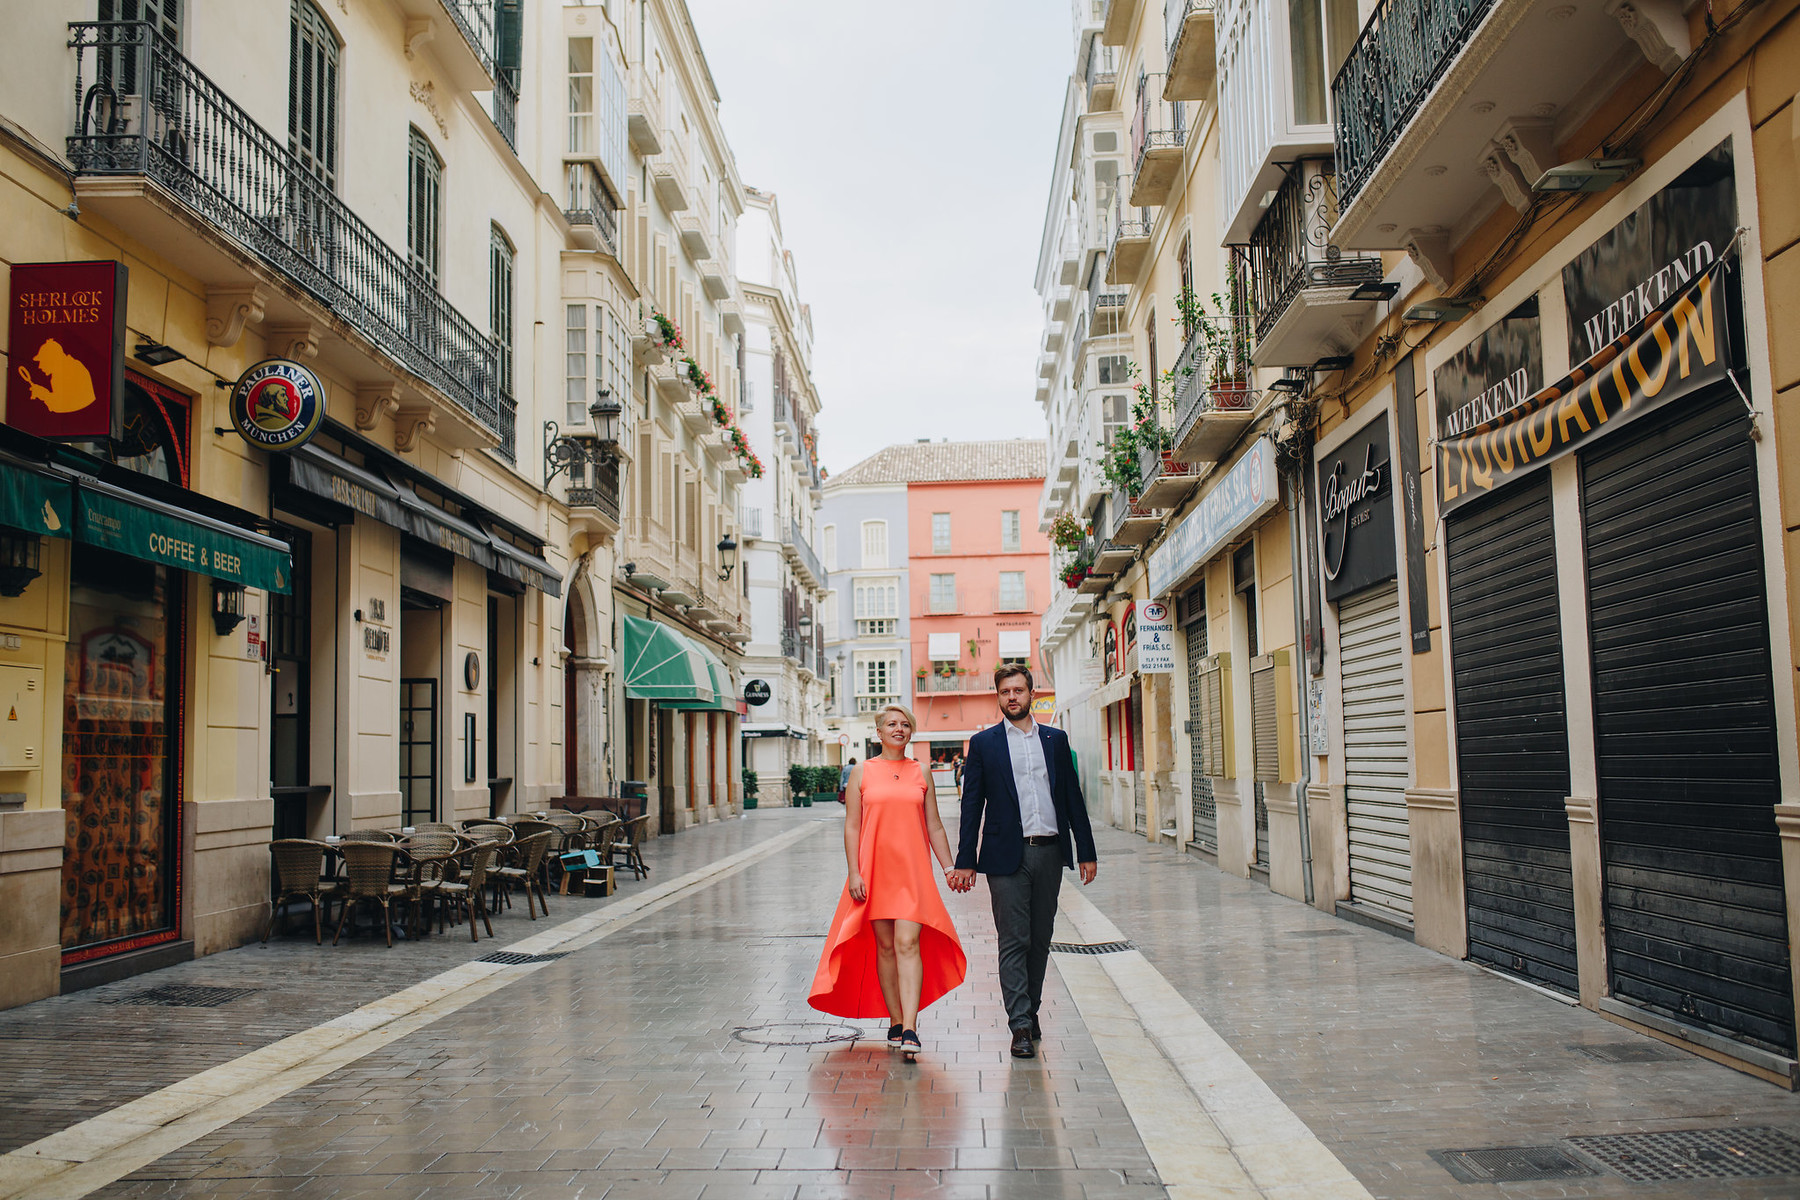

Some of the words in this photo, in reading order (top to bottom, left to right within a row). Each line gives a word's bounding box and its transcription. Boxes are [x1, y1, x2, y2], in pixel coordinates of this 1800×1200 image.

[20, 290, 103, 308] SHERLOCK
[1584, 240, 1715, 356] WEEKEND
[23, 307, 99, 325] HOLMES
[239, 365, 314, 400] PAULANER
[1442, 272, 1717, 502] LIQUIDATION
[1447, 367, 1529, 436] WEEKEND
[241, 418, 306, 444] MÜNCHEN
[149, 532, 195, 563] COFFEE
[200, 547, 208, 566] &
[213, 550, 241, 575] BEER
[1153, 632, 1160, 643] &
